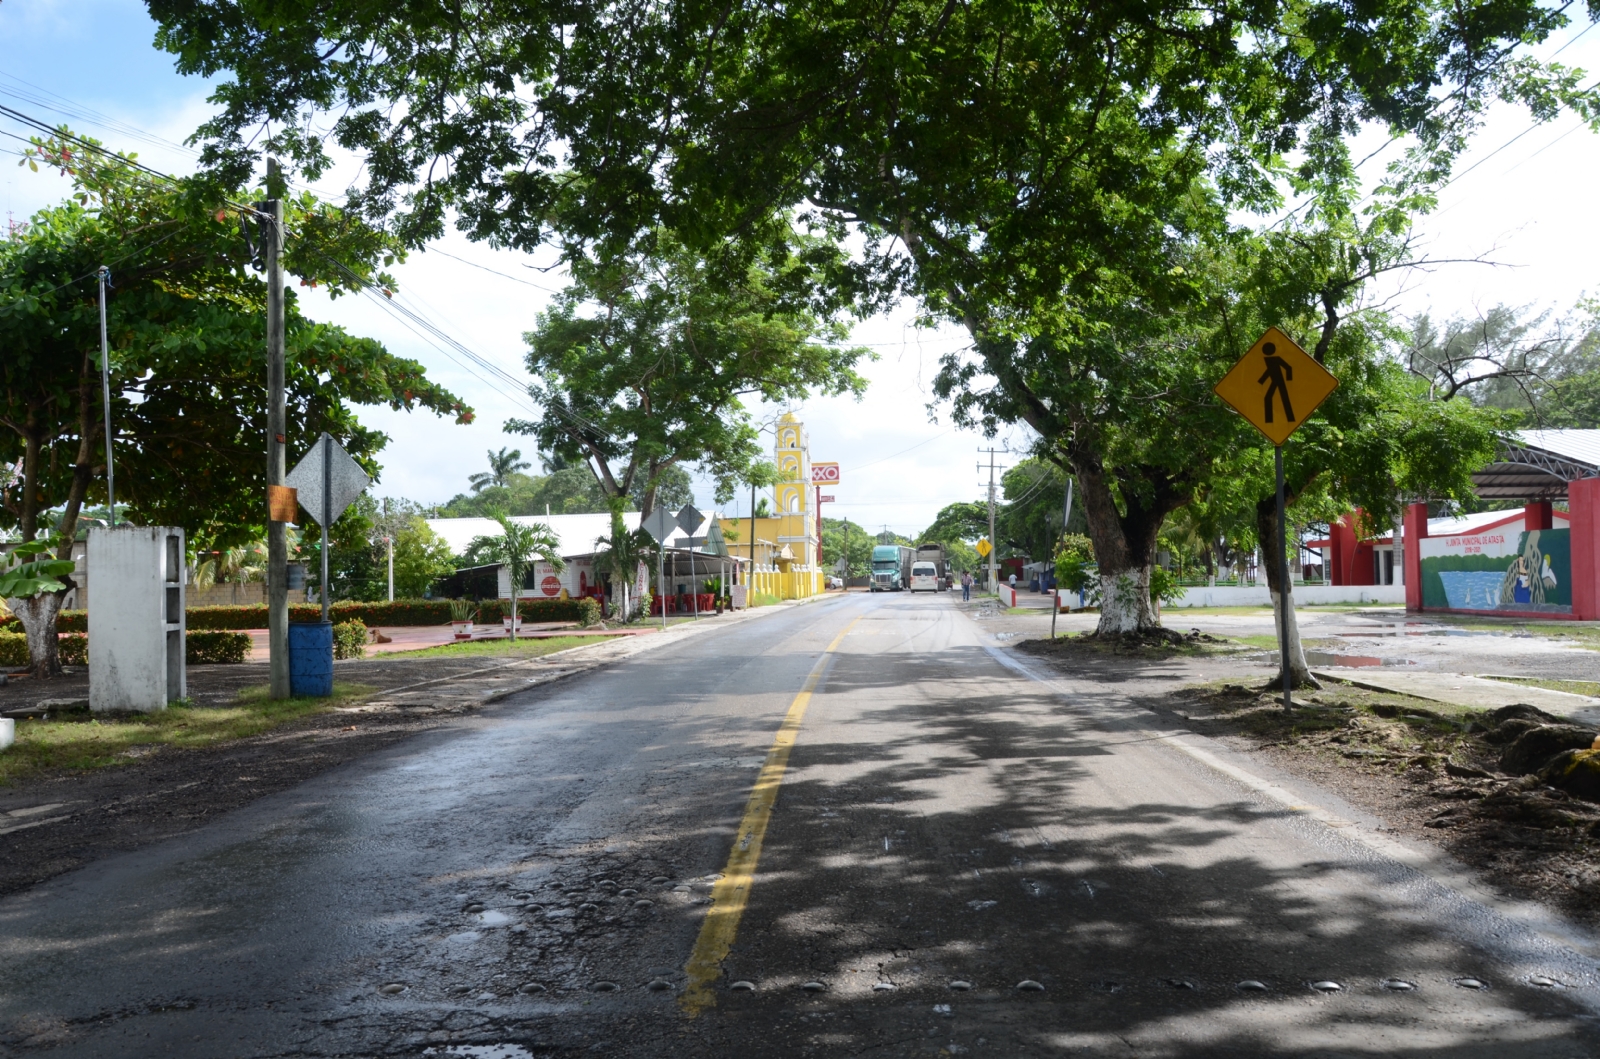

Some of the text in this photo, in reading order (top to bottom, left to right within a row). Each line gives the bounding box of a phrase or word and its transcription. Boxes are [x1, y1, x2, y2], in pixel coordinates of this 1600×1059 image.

[811, 466, 838, 480] XXO
[1450, 538, 1460, 546] JUNTA
[1462, 537, 1482, 545] MUNICIPAL
[1482, 536, 1488, 544] DE
[1488, 536, 1504, 544] ATASTA
